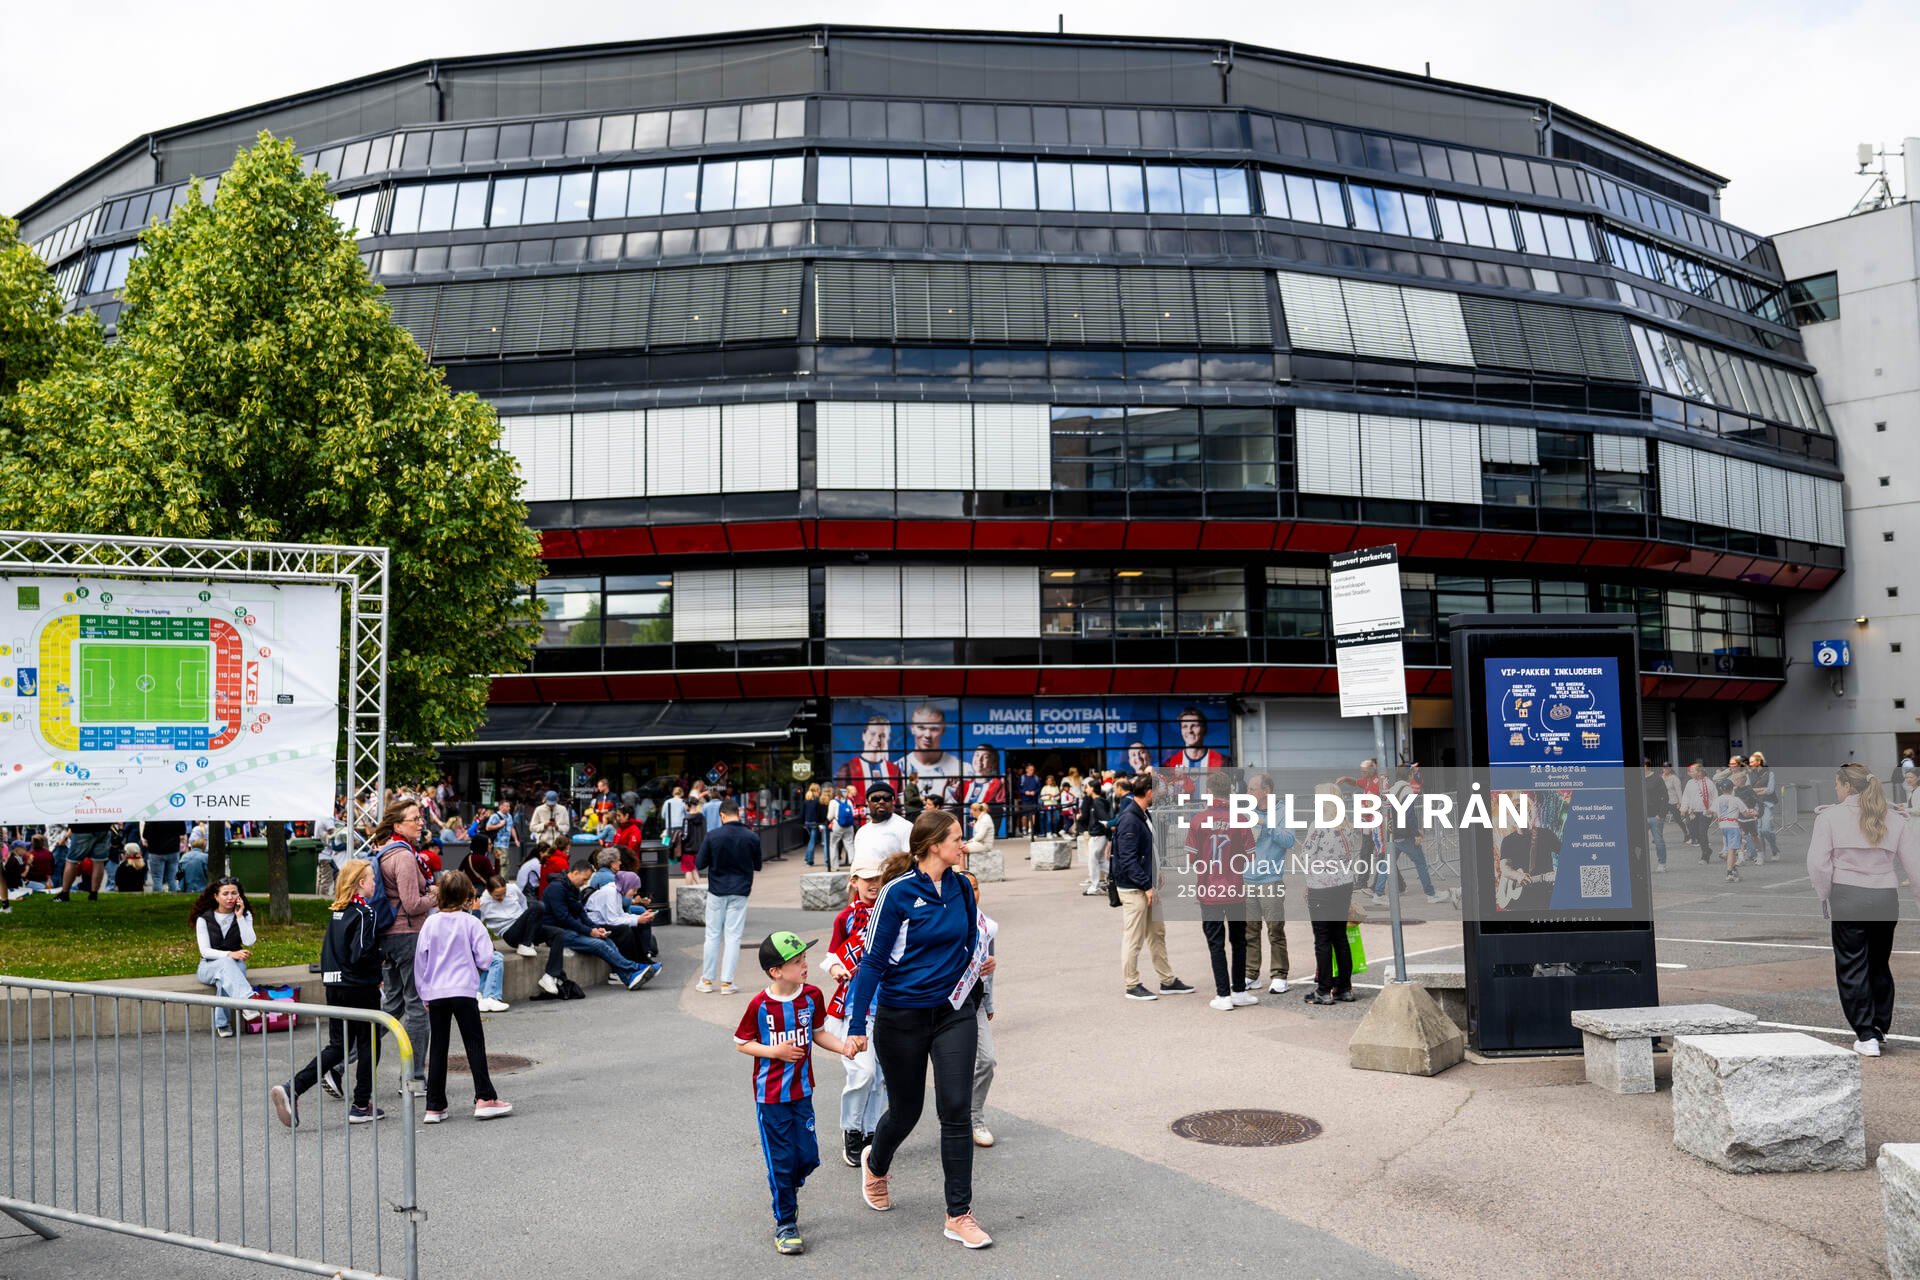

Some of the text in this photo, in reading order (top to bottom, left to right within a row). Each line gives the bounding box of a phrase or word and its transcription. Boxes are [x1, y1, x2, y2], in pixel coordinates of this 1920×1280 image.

[1333, 552, 1391, 567] Reservert parkering
[102, 594, 111, 603] 10
[1823, 652, 1832, 664] 2
[1501, 667, 1602, 676] VIP-PAKKEN INKLUDERER
[248, 663, 258, 702] VG
[989, 708, 1120, 722] MAKE FOOTBALL
[972, 722, 1137, 735] DREAMS COME TRUE
[792, 762, 811, 772] OPEN
[1530, 765, 1586, 773] Ed Sheeran
[193, 795, 250, 807] T-BANE
[766, 1014, 775, 1030] 9
[770, 1026, 810, 1046] NORGE
